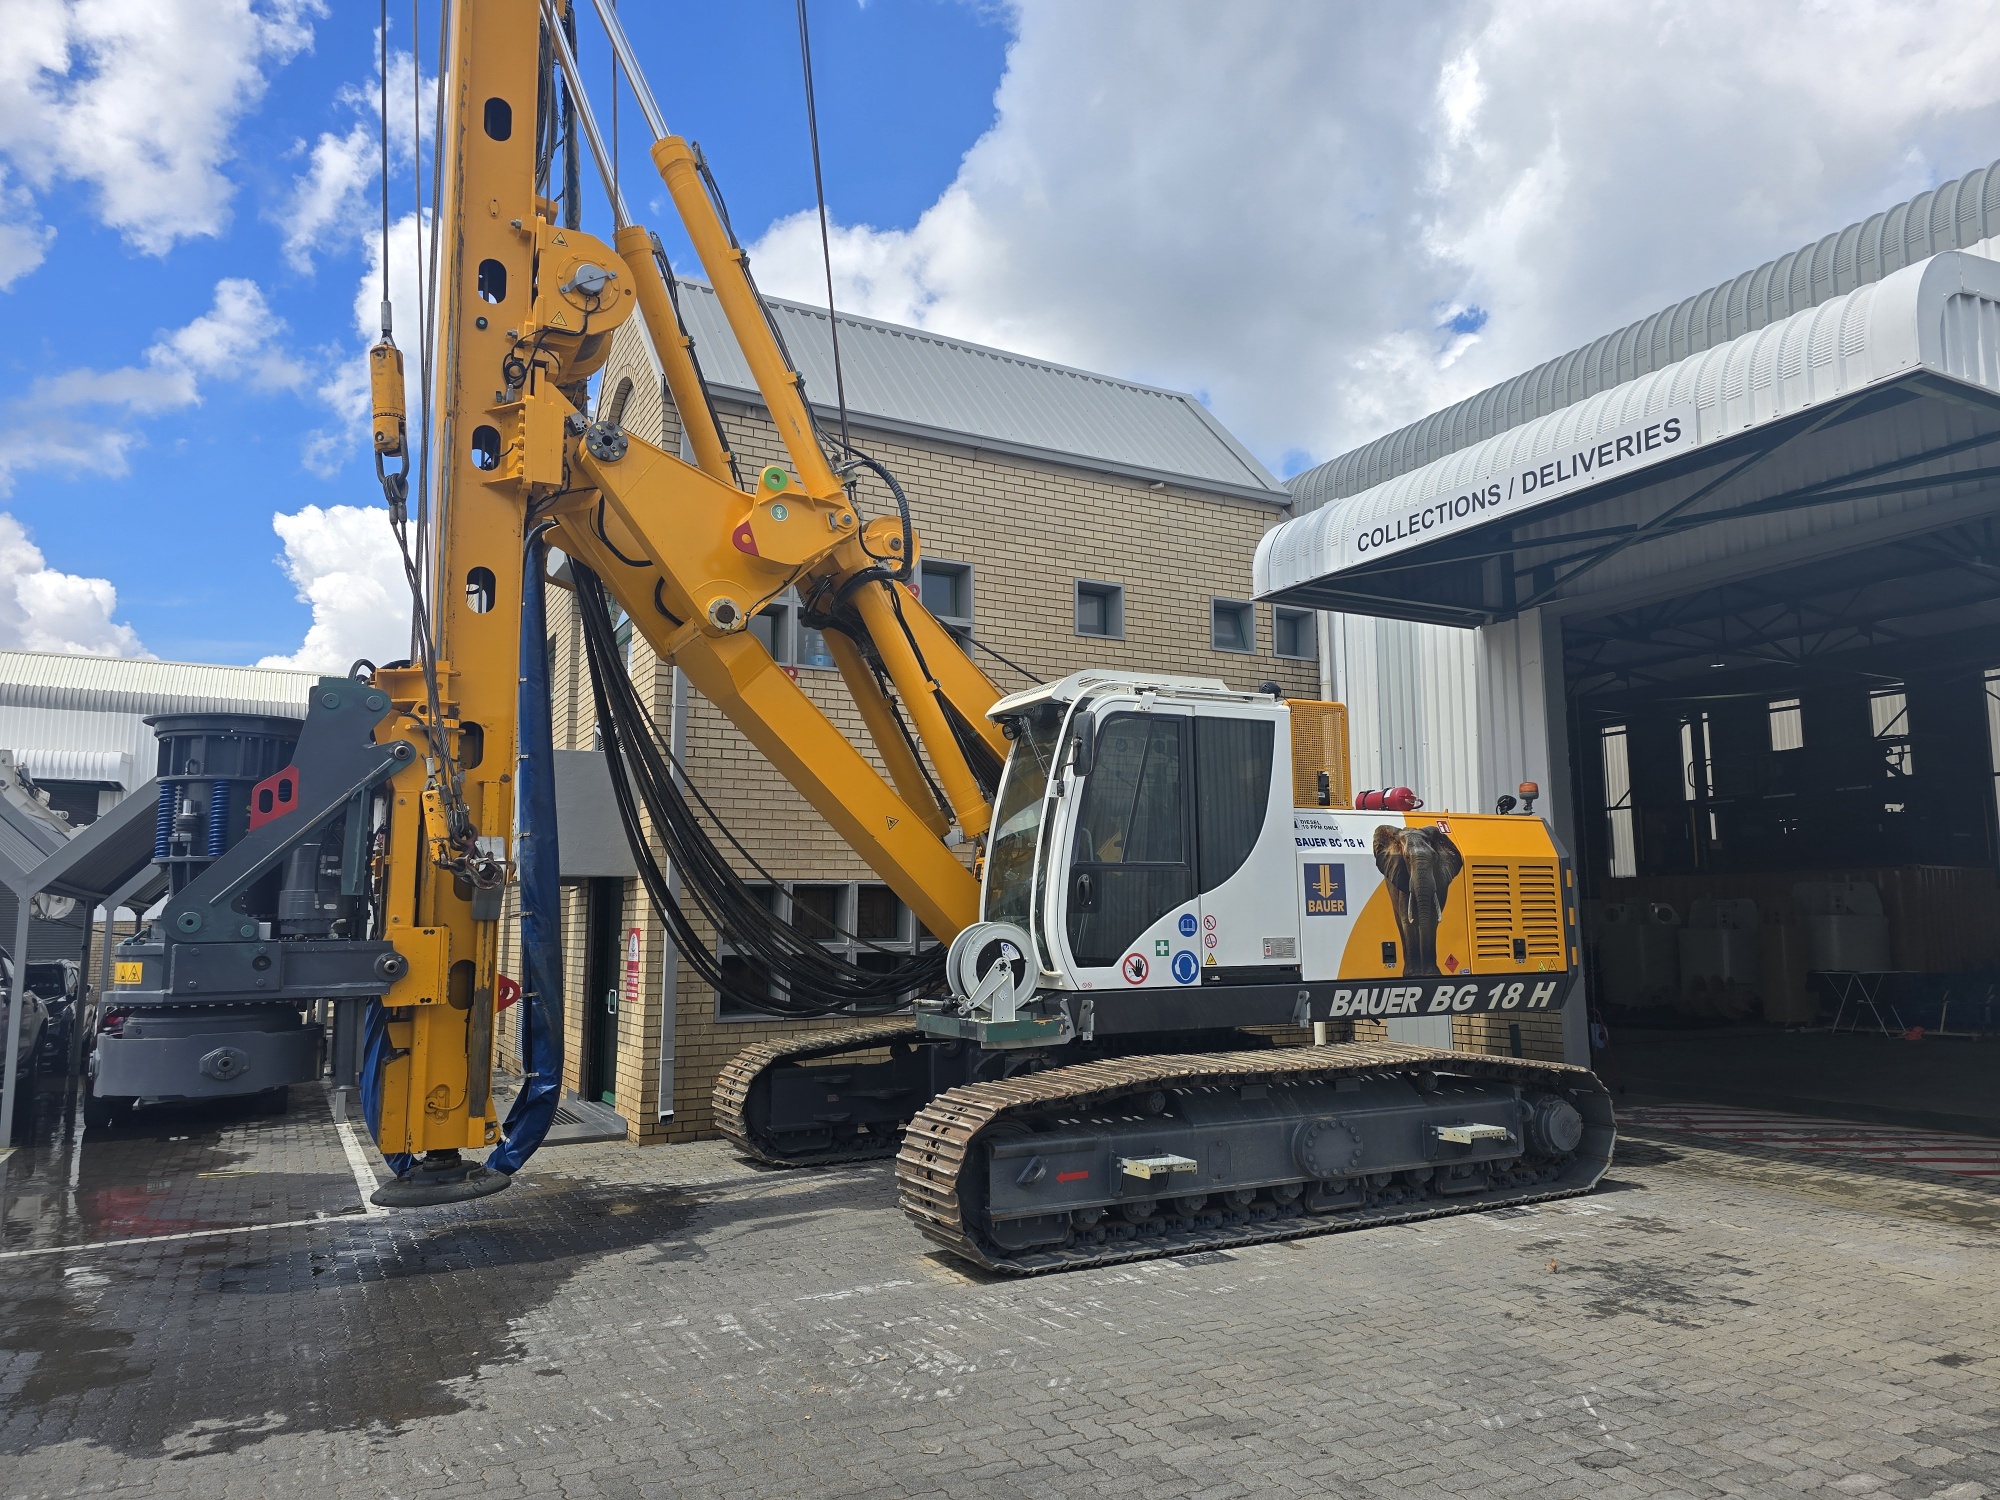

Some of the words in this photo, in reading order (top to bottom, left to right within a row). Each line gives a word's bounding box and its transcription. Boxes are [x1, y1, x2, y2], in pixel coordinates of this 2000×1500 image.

[1357, 484, 1500, 552] COLLECTIONS
[1508, 477, 1515, 500] /
[1522, 417, 1682, 494] DELIVERIES
[1295, 837, 1328, 847] BAUER
[1329, 838, 1342, 848] BG
[1344, 838, 1356, 848] 18
[1356, 838, 1365, 848] H
[1308, 900, 1345, 913] BAUER
[1329, 986, 1423, 1017] BAUER
[1427, 984, 1479, 1013] BG
[1487, 982, 1525, 1010] 18
[1527, 981, 1558, 1008] H
